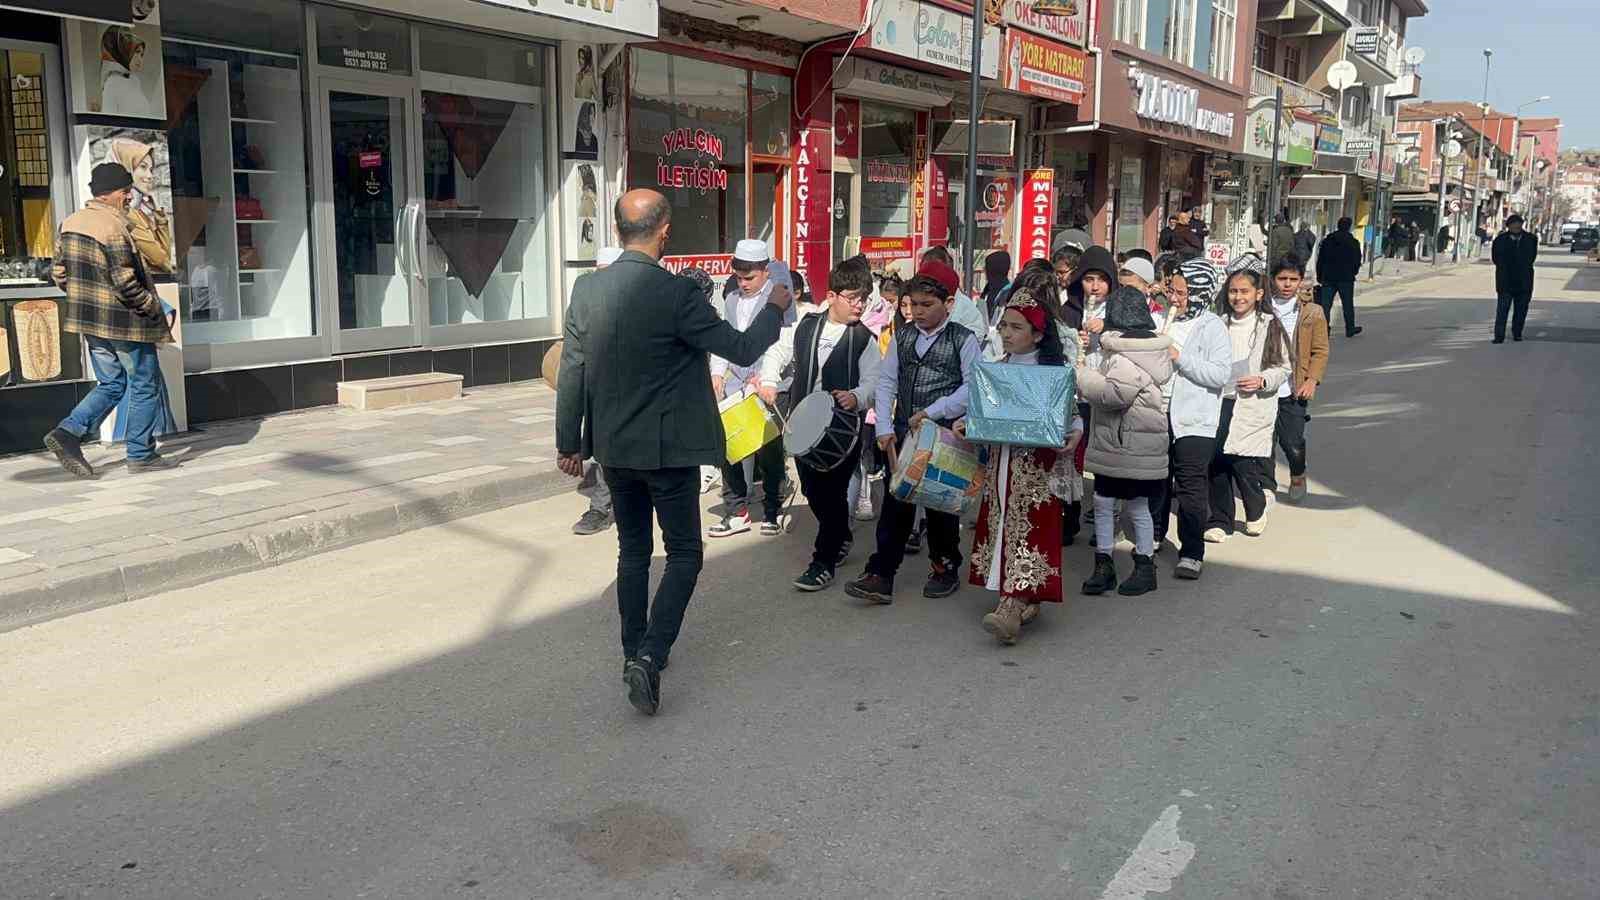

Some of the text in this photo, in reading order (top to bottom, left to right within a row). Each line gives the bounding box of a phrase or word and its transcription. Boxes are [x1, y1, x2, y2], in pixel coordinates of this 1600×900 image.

[1021, 37, 1043, 68] YÖRE
[663, 127, 723, 161] YALÇIN
[657, 156, 728, 196] İLETİŞİM
